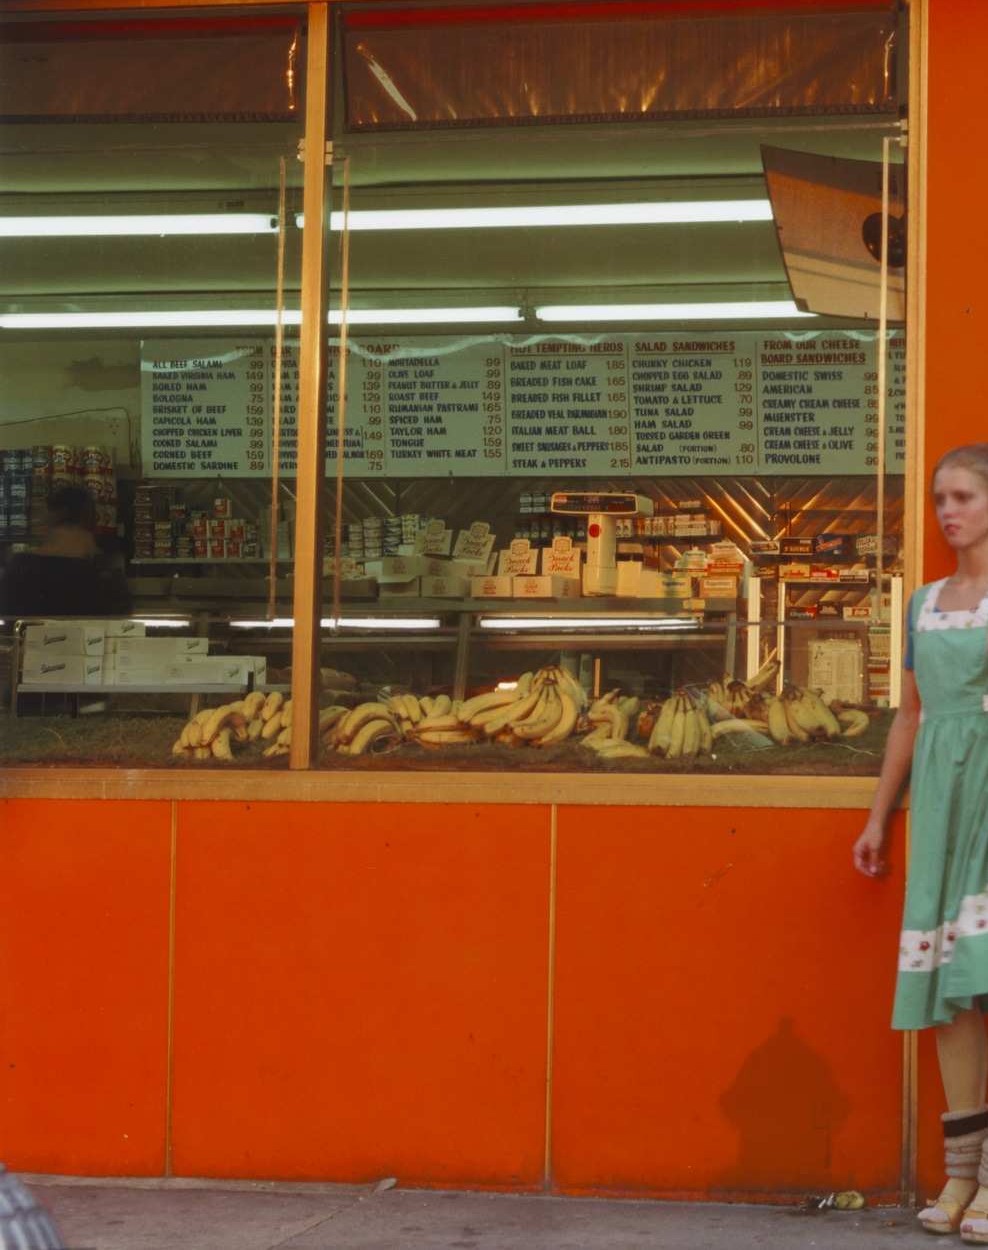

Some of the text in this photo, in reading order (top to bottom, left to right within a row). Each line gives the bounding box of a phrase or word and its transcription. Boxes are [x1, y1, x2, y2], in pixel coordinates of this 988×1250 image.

[634, 341, 735, 351] SALAD SANDWICHES
[764, 340, 792, 350] FROM
[632, 359, 668, 368] CHUNKY
[672, 358, 712, 367] CHICKEN
[760, 352, 866, 364] BOARD SANDWICHES
[693, 370, 722, 380] SALAD
[762, 371, 843, 381] DOMESTIC SWISS
[575, 376, 597, 386] CAKE
[671, 383, 703, 392] SALAD
[762, 384, 813, 395] AMERICAN
[388, 392, 416, 401] ROAST
[572, 392, 601, 402] FILLET
[633, 396, 669, 405] TOMATO
[681, 395, 722, 404] LETTUCE
[799, 398, 830, 409] CREAM
[832, 398, 861, 408] CHEESE
[191, 405, 203, 414] OF
[634, 408, 659, 416] TUNA
[665, 407, 694, 416] SALAD
[196, 417, 217, 425] HAM
[423, 415, 443, 424] HAM
[763, 412, 815, 423] MUENSTER
[634, 420, 656, 429] HAM
[662, 419, 692, 428] SALAD
[390, 427, 423, 436] TAYLOR
[426, 427, 447, 435] HAM
[511, 426, 542, 435] ITALIAN
[545, 426, 568, 435] MEAT
[572, 425, 597, 435] BALL
[764, 426, 792, 437] CREAM
[794, 426, 821, 436] CHEESE
[828, 426, 855, 436] JELLY
[702, 431, 731, 440] GREEN
[390, 438, 425, 447] TONGUE
[764, 440, 792, 450] CREAM
[793, 440, 820, 449] CHEESE
[828, 440, 854, 450] OLIVE
[454, 449, 478, 458] MEAT
[636, 444, 664, 453] SALAD
[512, 458, 538, 468] STEAK
[548, 458, 587, 468] PEPPERS
[636, 455, 691, 465] ANTIPASTO
[764, 453, 821, 464] PROVOLONE
[153, 461, 240, 470] DOMESTIC SARDINE
